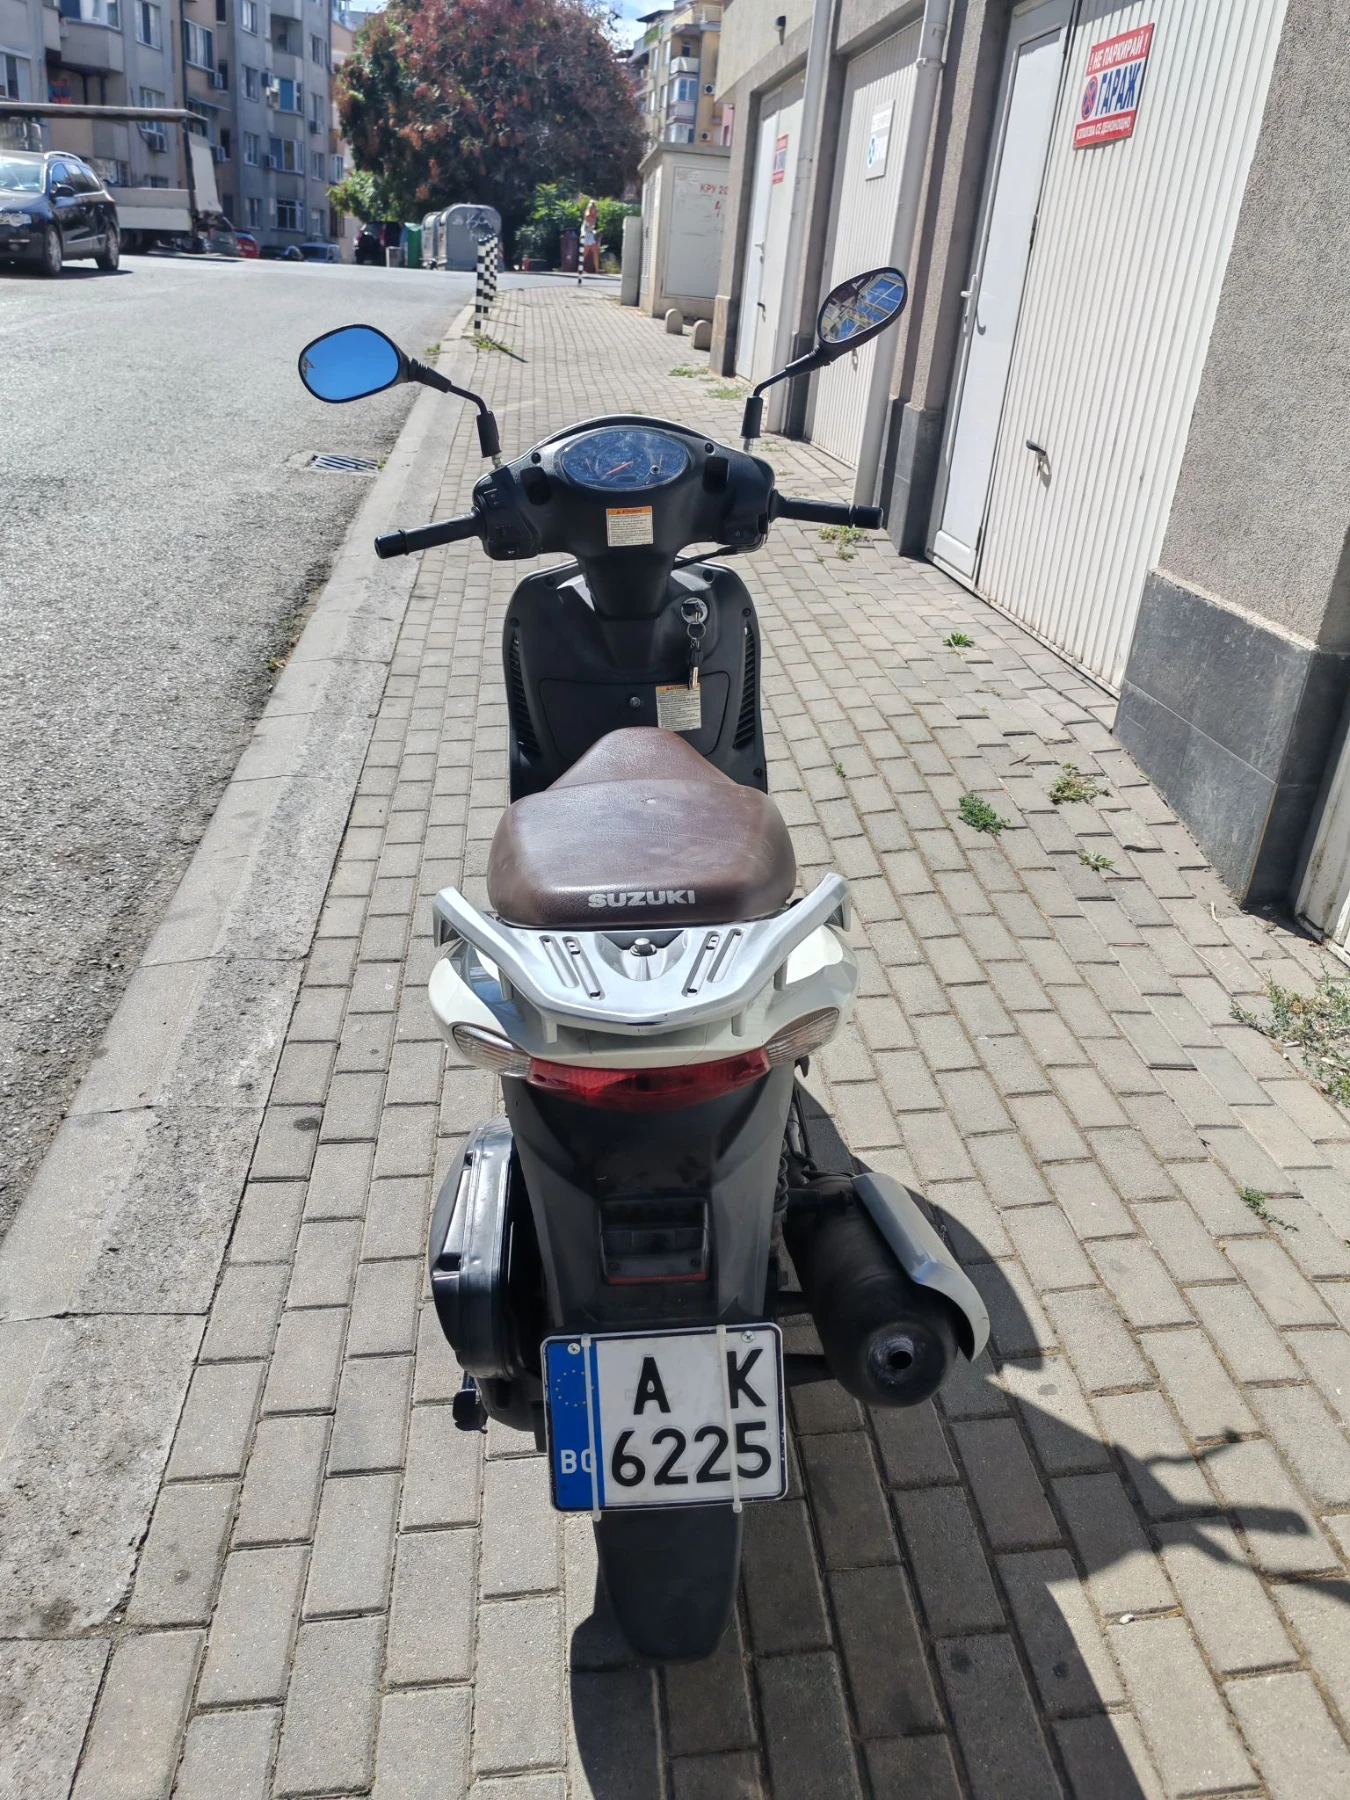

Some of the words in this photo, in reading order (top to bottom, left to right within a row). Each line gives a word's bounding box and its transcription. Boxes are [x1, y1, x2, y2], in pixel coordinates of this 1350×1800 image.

[1095, 62, 1142, 117] ГАРАЖ
[588, 890, 696, 908] SUZUKI
[633, 1356, 671, 1415] A
[726, 1348, 767, 1410] K
[611, 1421, 772, 1487] 6225
